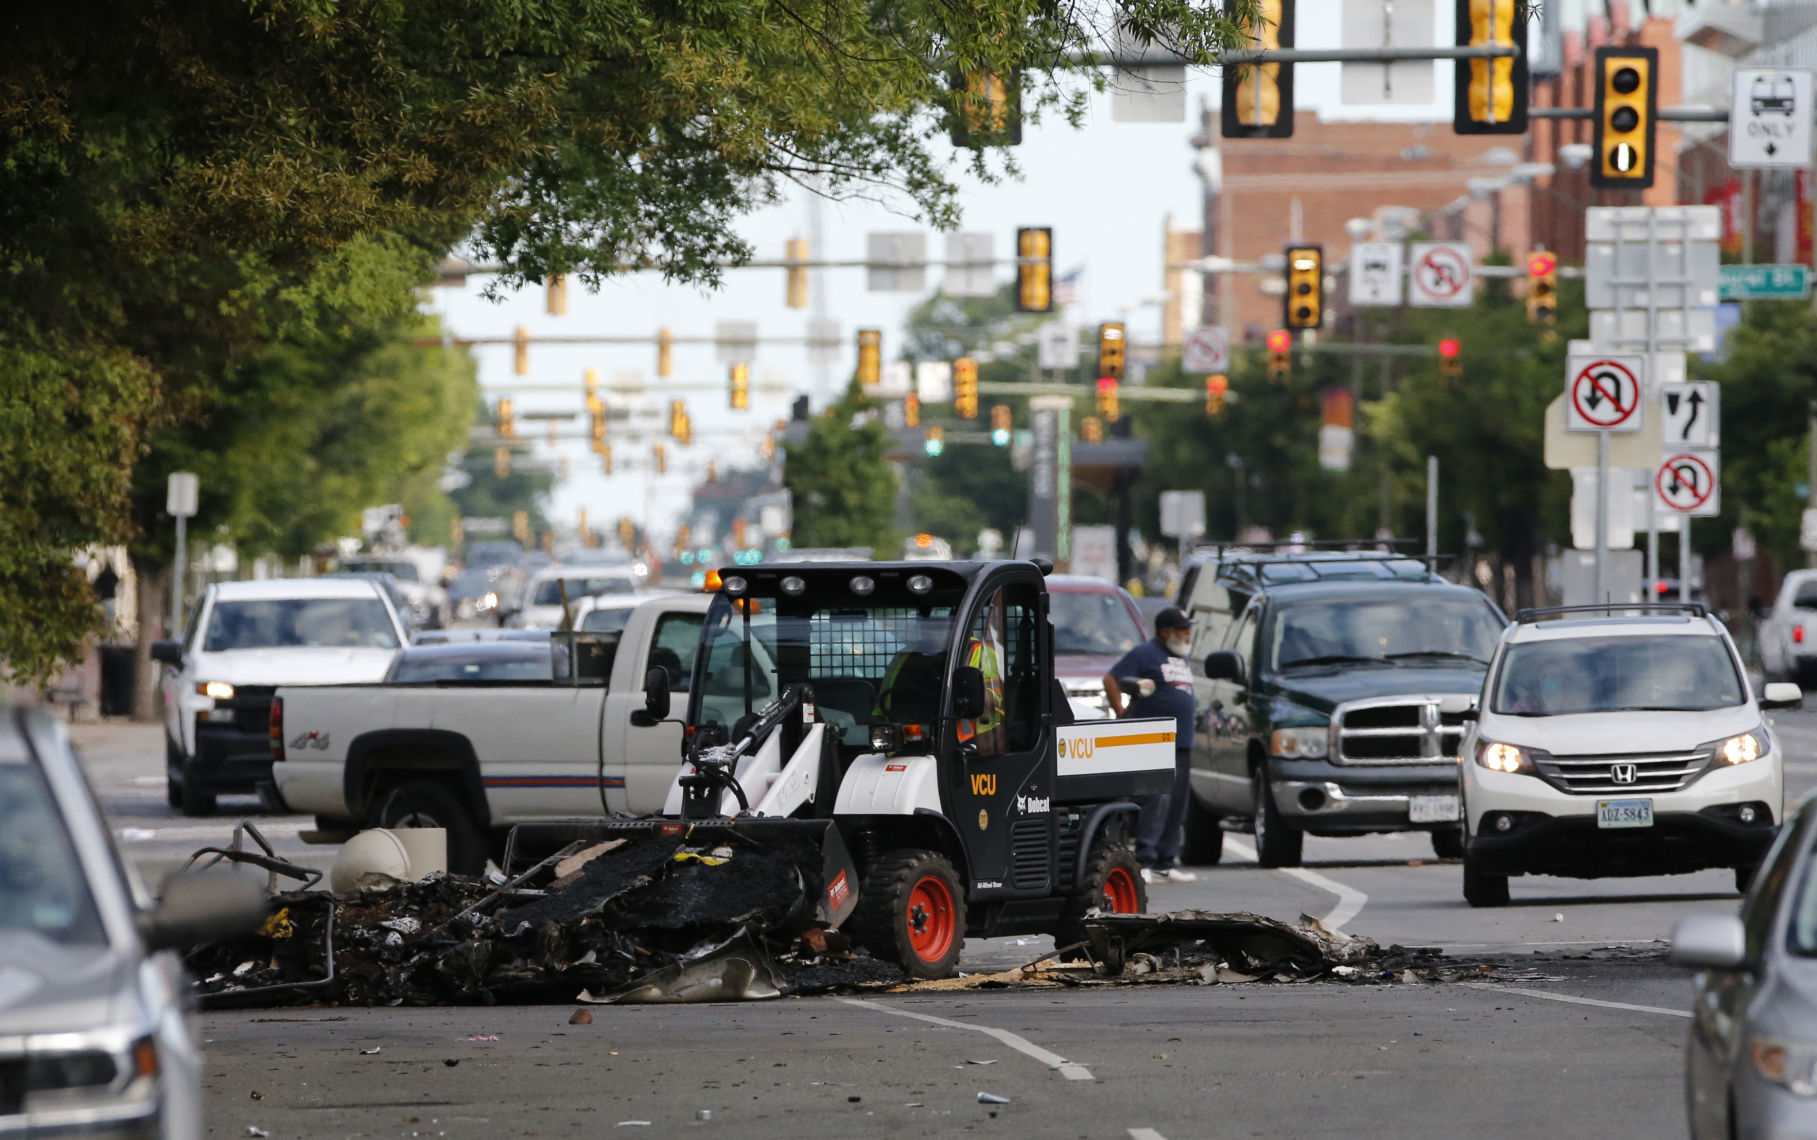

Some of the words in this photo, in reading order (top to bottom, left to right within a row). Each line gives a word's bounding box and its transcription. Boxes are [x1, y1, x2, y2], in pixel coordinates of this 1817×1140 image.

[1747, 121, 1796, 138] ONLY
[1068, 738, 1093, 759] VCU
[970, 773, 997, 796] VCU
[1027, 796, 1050, 814] Bobcat
[1601, 807, 1650, 821] ADZ-5843
